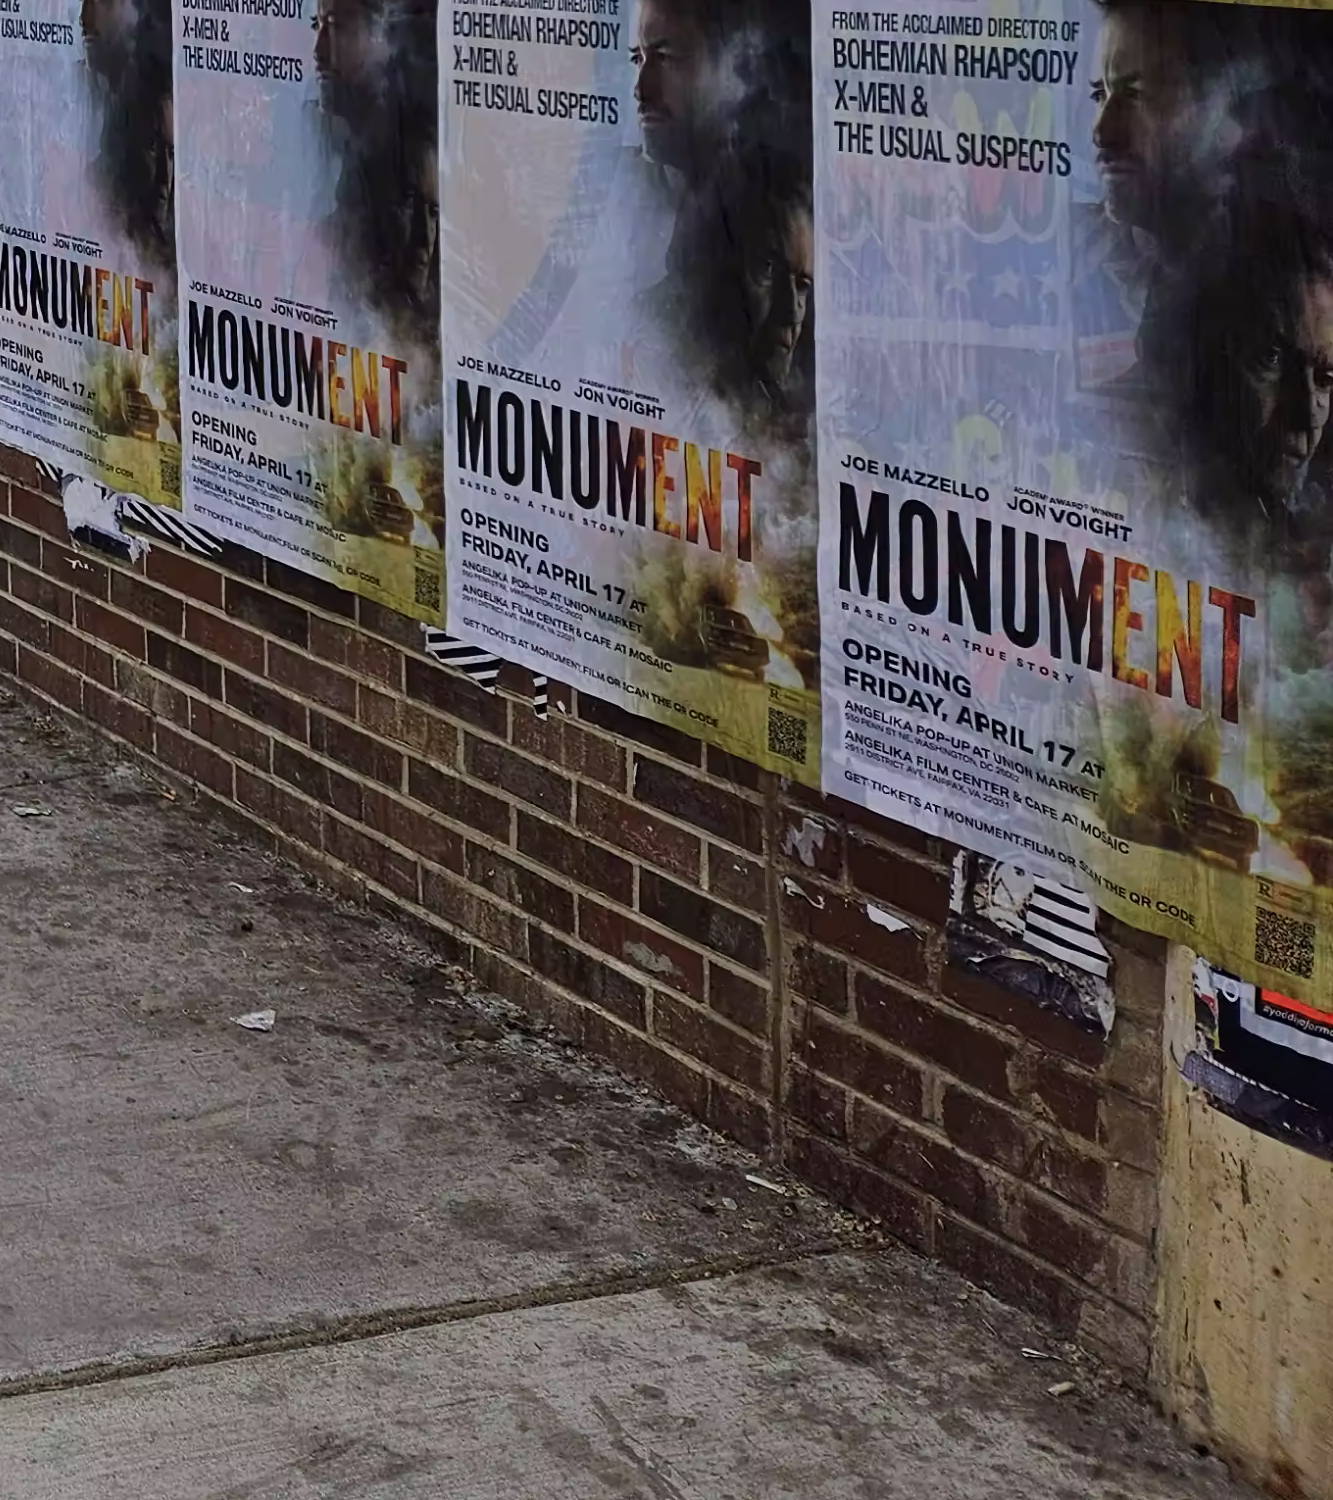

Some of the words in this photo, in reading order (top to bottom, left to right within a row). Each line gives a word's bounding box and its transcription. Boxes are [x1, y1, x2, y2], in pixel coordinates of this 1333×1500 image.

[452, 10, 531, 42] BOHEMIAN
[535, 16, 620, 50] RHAPSODY
[831, 10, 870, 32] FROM
[872, 12, 899, 33] THE
[902, 13, 983, 36] ACCLAIMED
[987, 17, 1057, 40] DIRECTOR
[1061, 20, 1079, 42] OF
[182, 44, 204, 69] THE
[205, 47, 241, 74] USUAL
[242, 52, 303, 82] SUSPECTS
[833, 37, 947, 75] BOHEMIAN
[954, 44, 1077, 84] RHAPSODY
[452, 78, 481, 108] THE
[483, 82, 533, 114] USUAL
[537, 89, 618, 124] SUSPECTS
[834, 79, 906, 115] X-MEN
[910, 84, 928, 118] &
[833, 120, 874, 155] THE
[879, 124, 951, 163] USUAL
[956, 132, 1071, 176] SUSPECTS
[188, 279, 208, 294] JOE
[209, 284, 262, 309] MAZZELLO
[270, 303, 294, 318] JON
[294, 308, 338, 330] VOIGHT
[35, 368, 70, 392] APRIL
[71, 381, 85, 397] 17
[188, 300, 408, 447] MONUMENT
[456, 355, 484, 372] JOE
[487, 362, 561, 392] MAZZELLO
[573, 385, 604, 404] JON
[606, 393, 665, 420] VOIGHT
[191, 410, 257, 446] OPENING
[191, 430, 246, 463] FRIDAY,
[246, 451, 292, 480] APRIL
[295, 469, 312, 487] 17
[455, 378, 763, 563] MONUMENT
[840, 454, 879, 475] JOE
[883, 463, 989, 502] MAZZELLO
[1006, 496, 1047, 519] JON
[1049, 507, 1132, 542] VOIGHT
[460, 508, 549, 552] OPENING
[461, 531, 532, 575] FRIDAY,
[536, 559, 597, 596] APRIL
[602, 583, 626, 605] 17
[629, 599, 647, 613] AT
[838, 481, 1257, 725] MONUMENT
[840, 601, 897, 626] BASED
[907, 622, 930, 637] ON
[941, 632, 951, 644] A
[961, 638, 1006, 662] TRUE
[1016, 657, 1074, 683] STORY
[842, 638, 971, 698] OPENING
[844, 666, 947, 721] FRIDAY,
[955, 705, 1033, 754] APRIL
[1043, 740, 1076, 767] 17
[1080, 760, 1105, 779] AT
[844, 700, 913, 733] ANGELIKA
[915, 724, 971, 752] POP-UP
[971, 745, 990, 760] AT
[992, 752, 1033, 778] UNION
[1035, 772, 1098, 802] MARKET
